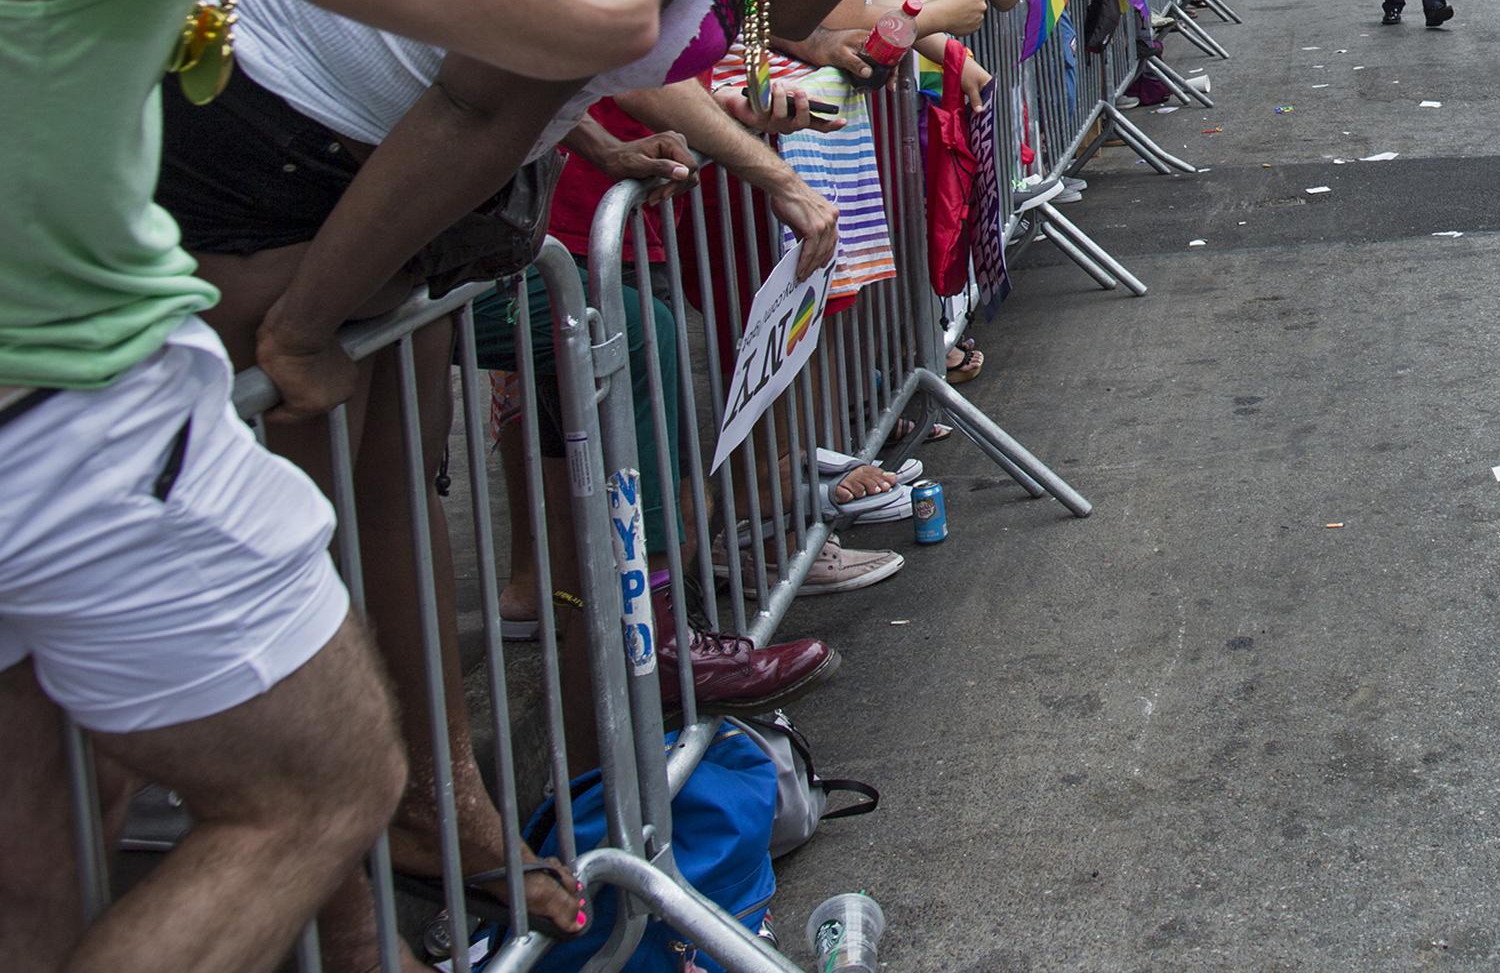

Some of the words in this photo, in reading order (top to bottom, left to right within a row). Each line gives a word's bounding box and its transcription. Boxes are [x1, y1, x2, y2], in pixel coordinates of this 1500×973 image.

[981, 89, 998, 208] THANK
[988, 211, 1006, 285] YOU
[610, 469, 654, 666] NYPD
